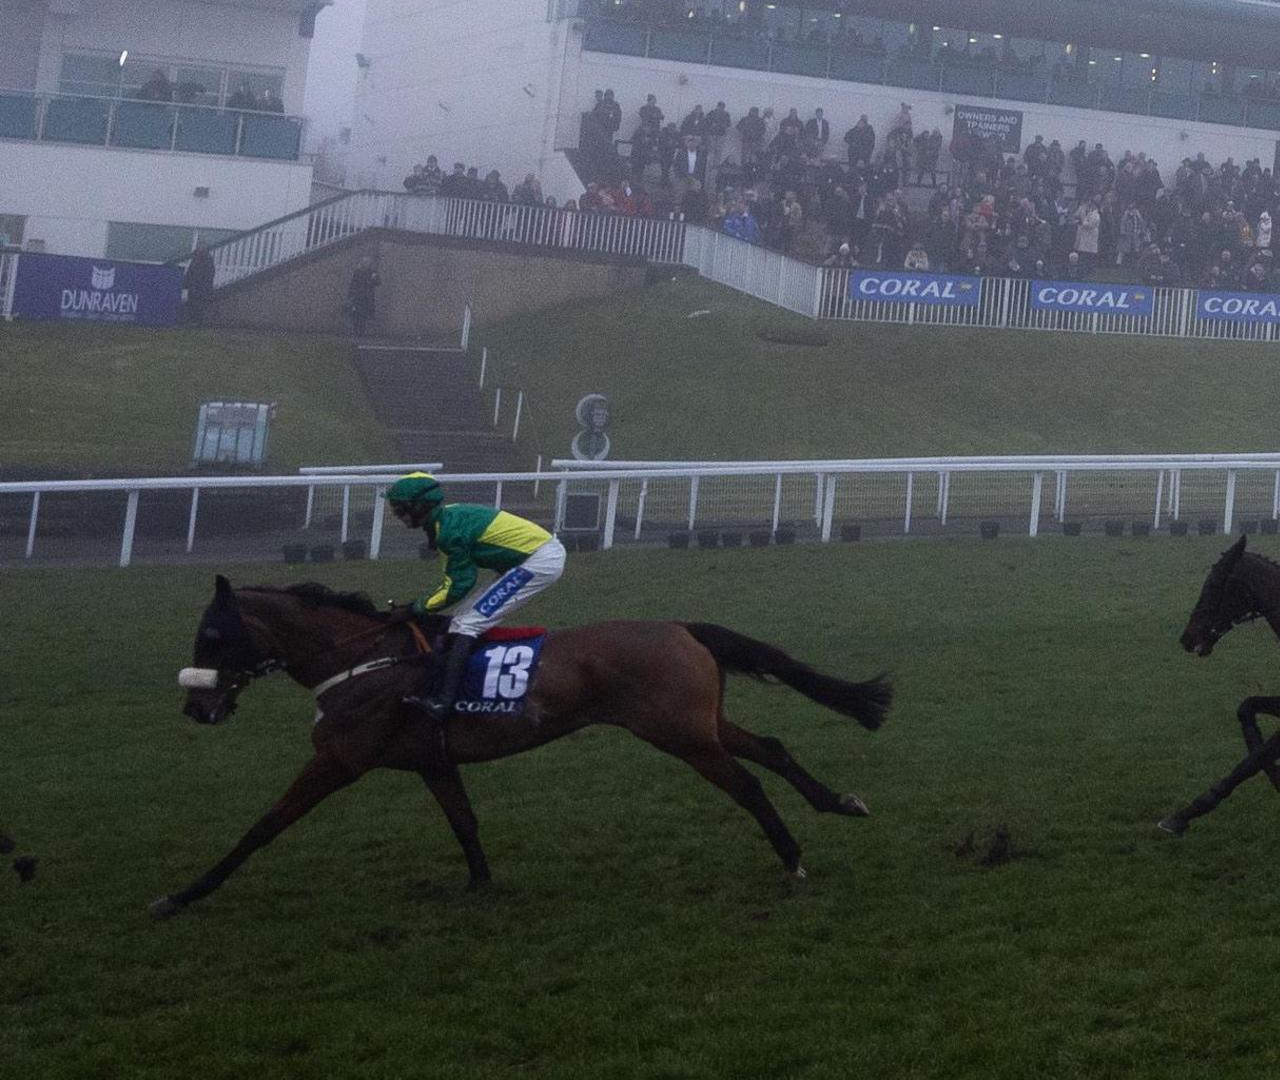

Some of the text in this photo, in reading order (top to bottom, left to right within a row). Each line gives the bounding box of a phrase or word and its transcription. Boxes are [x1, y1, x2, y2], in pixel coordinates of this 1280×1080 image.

[958, 111, 1018, 125] OWNERS AND
[860, 277, 956, 299] CORAL
[1038, 287, 1129, 308] CORAL
[61, 290, 138, 312] DUNRAVEN
[480, 574, 523, 614] CORAL
[482, 645, 534, 699] 13
[454, 700, 516, 712] CORAL
